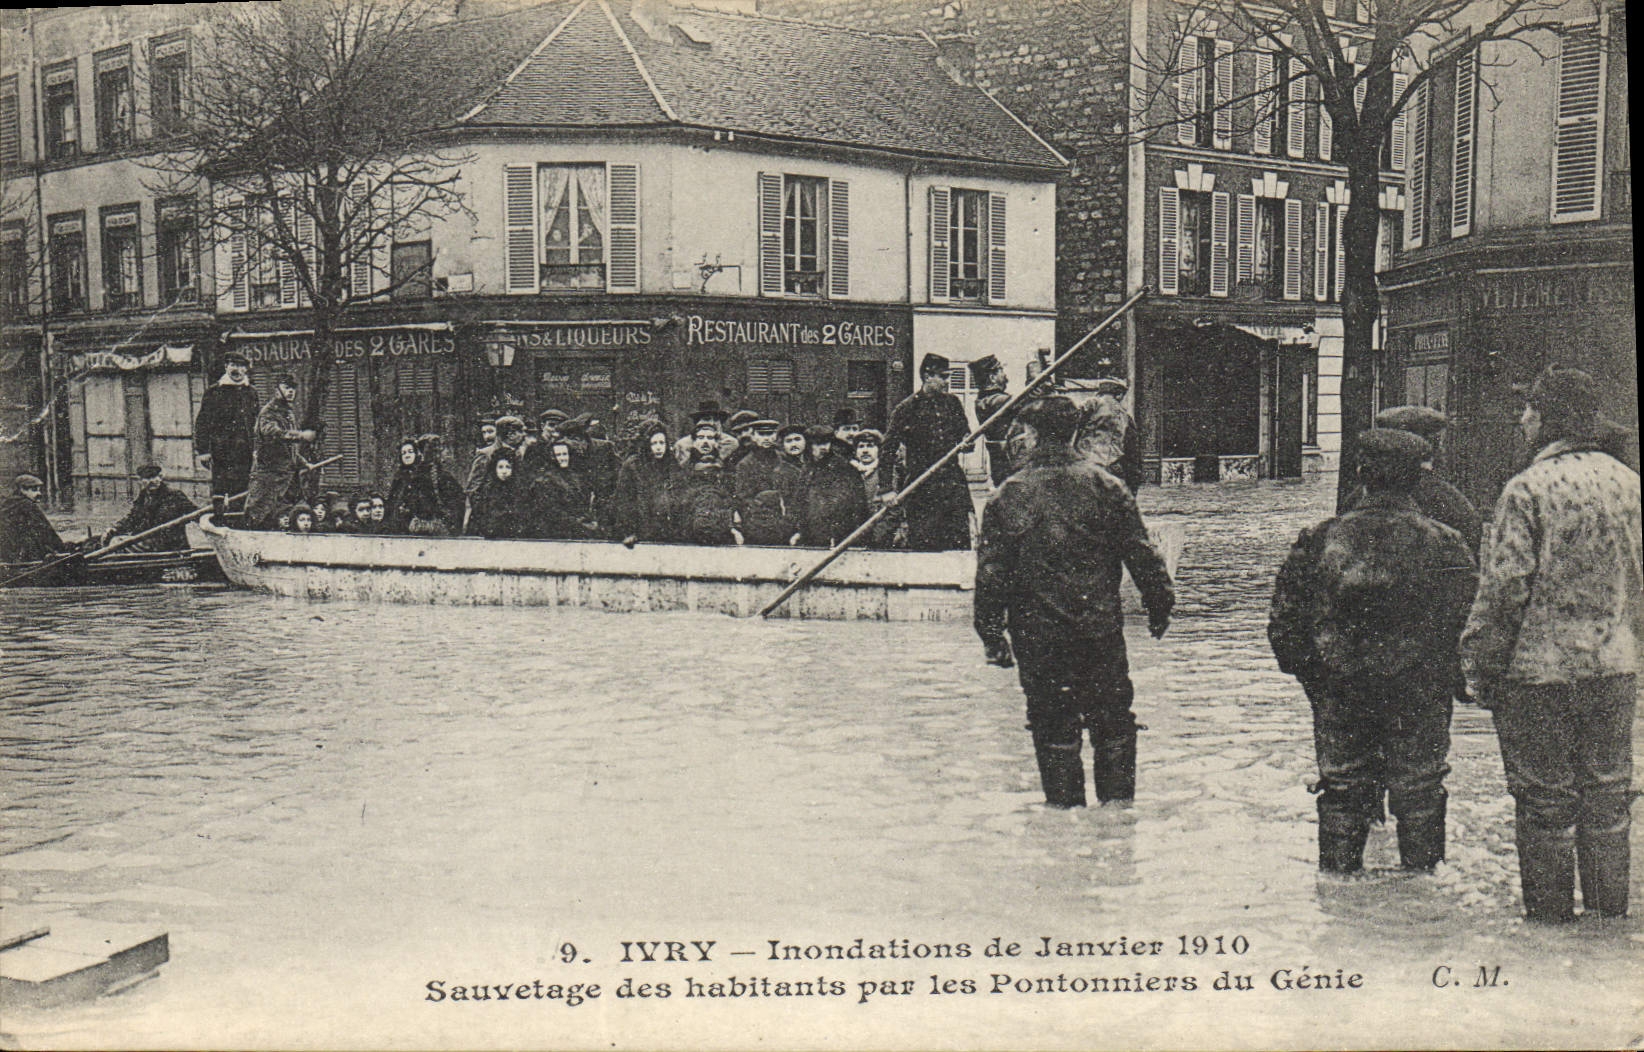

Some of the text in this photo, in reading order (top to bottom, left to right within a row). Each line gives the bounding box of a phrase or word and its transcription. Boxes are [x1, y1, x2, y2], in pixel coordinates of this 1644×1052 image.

[686, 314, 896, 346] RESTAURANT des 2 GARES
[334, 340, 365, 358] DES
[369, 335, 385, 356] 2
[388, 332, 455, 356] GARES
